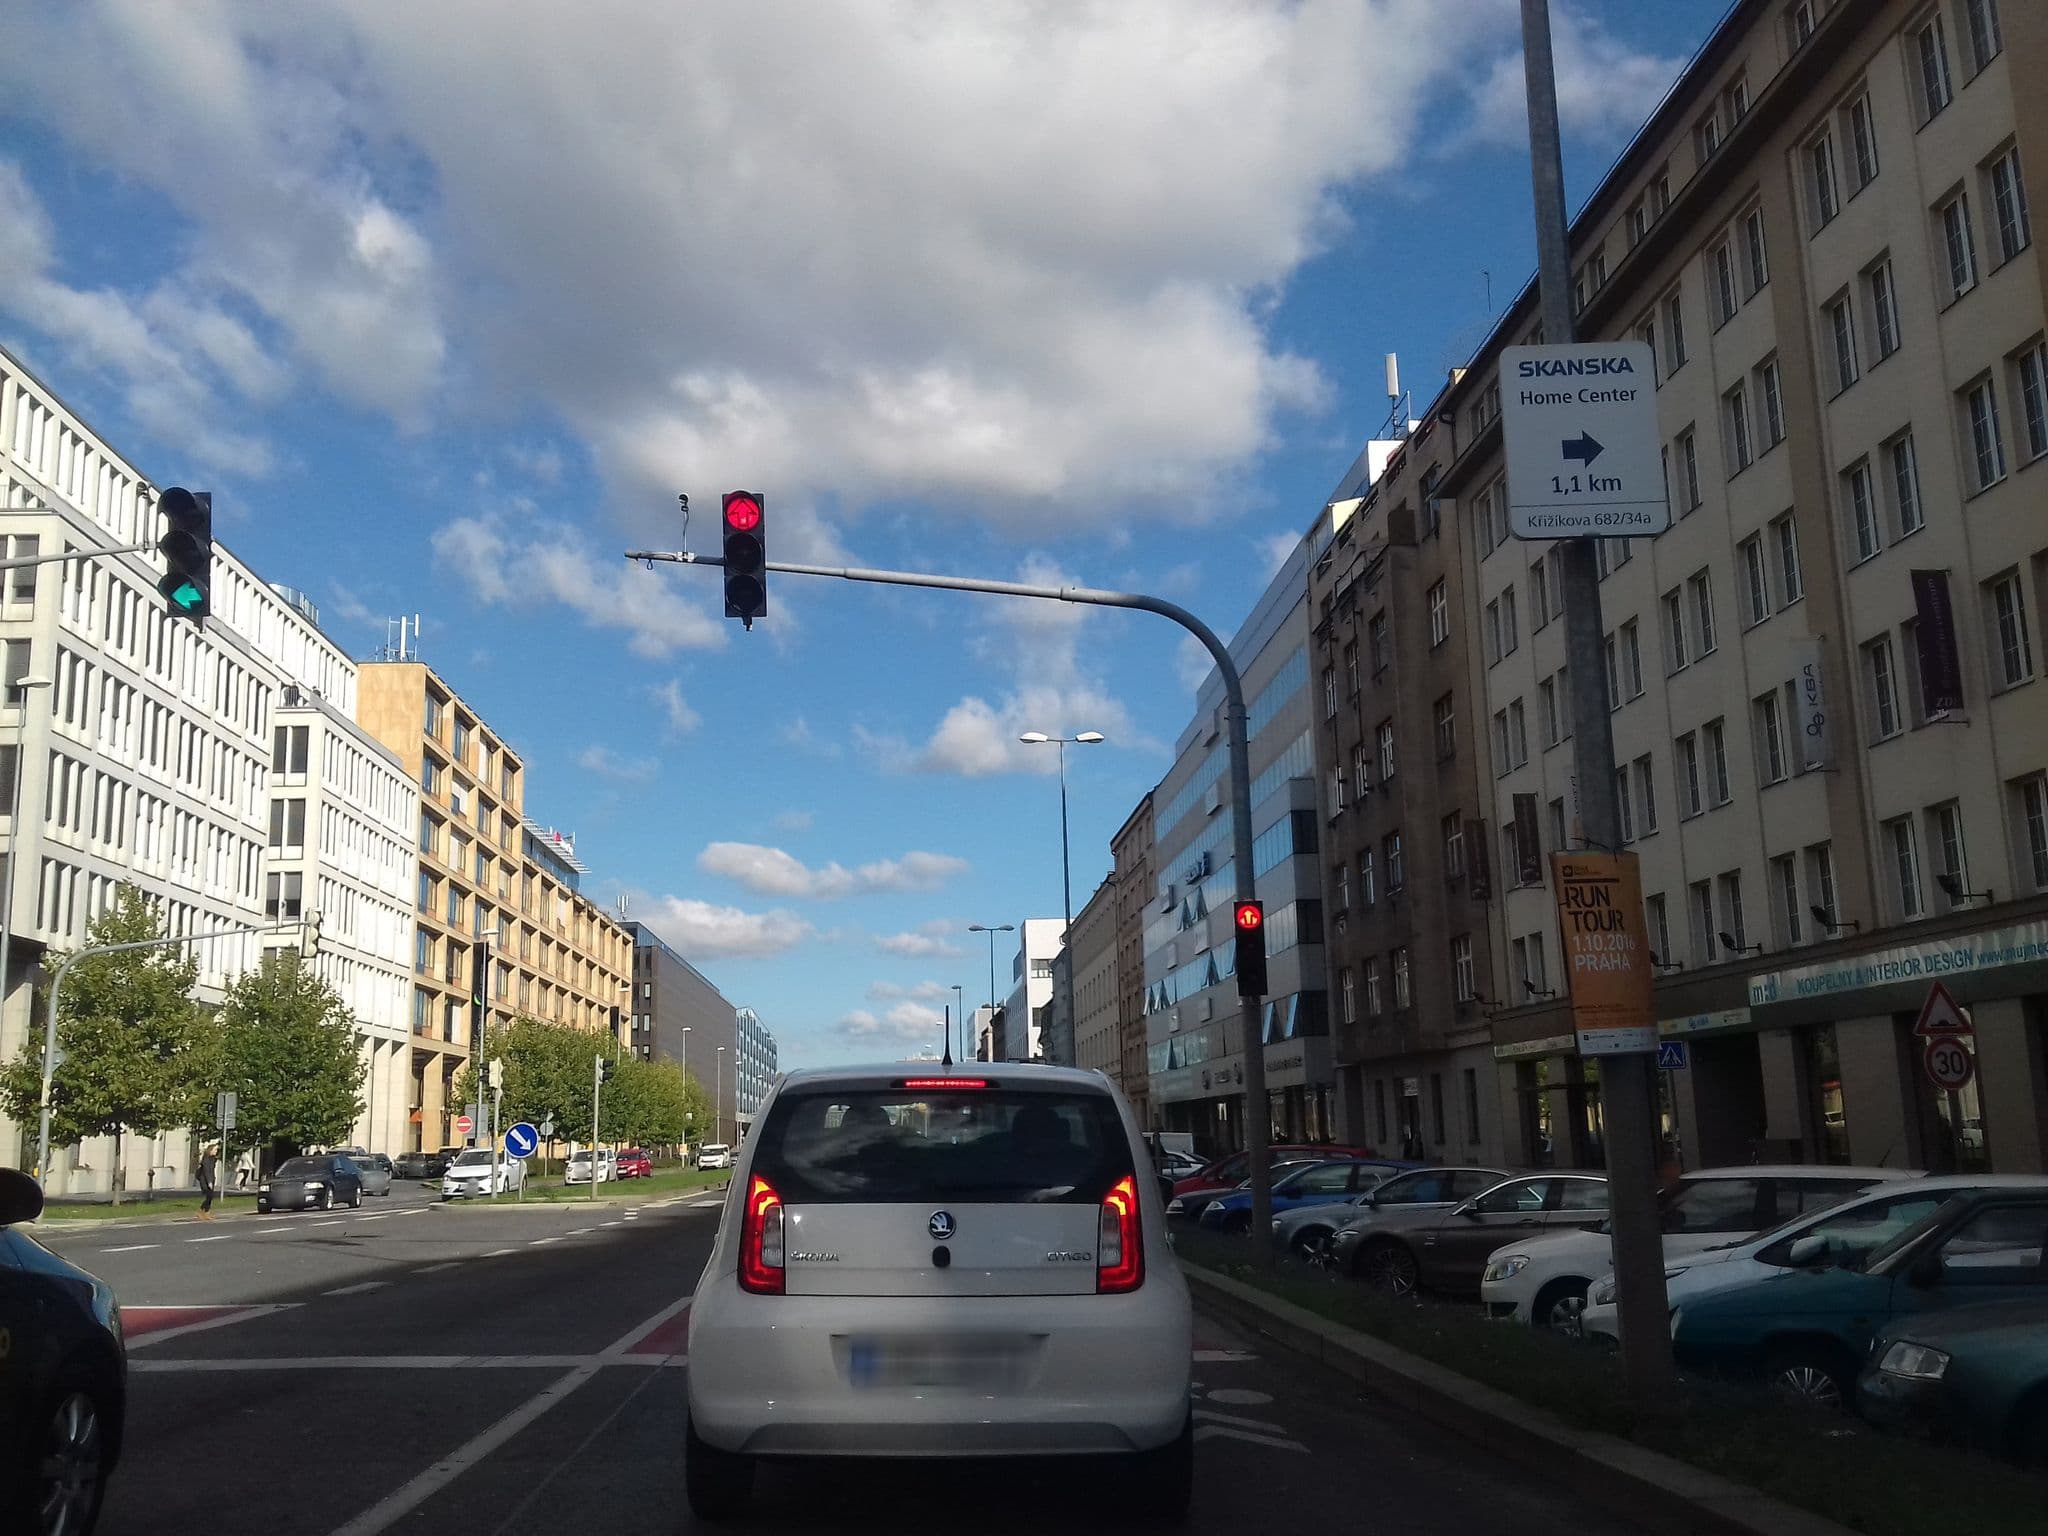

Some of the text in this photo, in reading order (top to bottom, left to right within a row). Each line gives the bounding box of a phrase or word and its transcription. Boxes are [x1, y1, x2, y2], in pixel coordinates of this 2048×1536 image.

[1518, 357, 1634, 378] SKANSKA
[1520, 387, 1637, 405] Home Center
[1551, 474, 1622, 495] 1,1 km
[1527, 511, 1651, 528] Křižíkova 682/34a
[1802, 663, 1819, 707] KBA
[1563, 886, 1611, 909] RUN
[1568, 909, 1624, 933] TOUR
[1572, 933, 1636, 952] 1.10.2016
[1574, 953, 1632, 974] PRAHA
[1796, 969, 1852, 995] KOUPELNY
[1865, 957, 1922, 983] INTERIOR
[1924, 947, 1974, 973] DESIGN
[1935, 1051, 1964, 1075] 30
[1047, 1250, 1092, 1262] CITIGO
